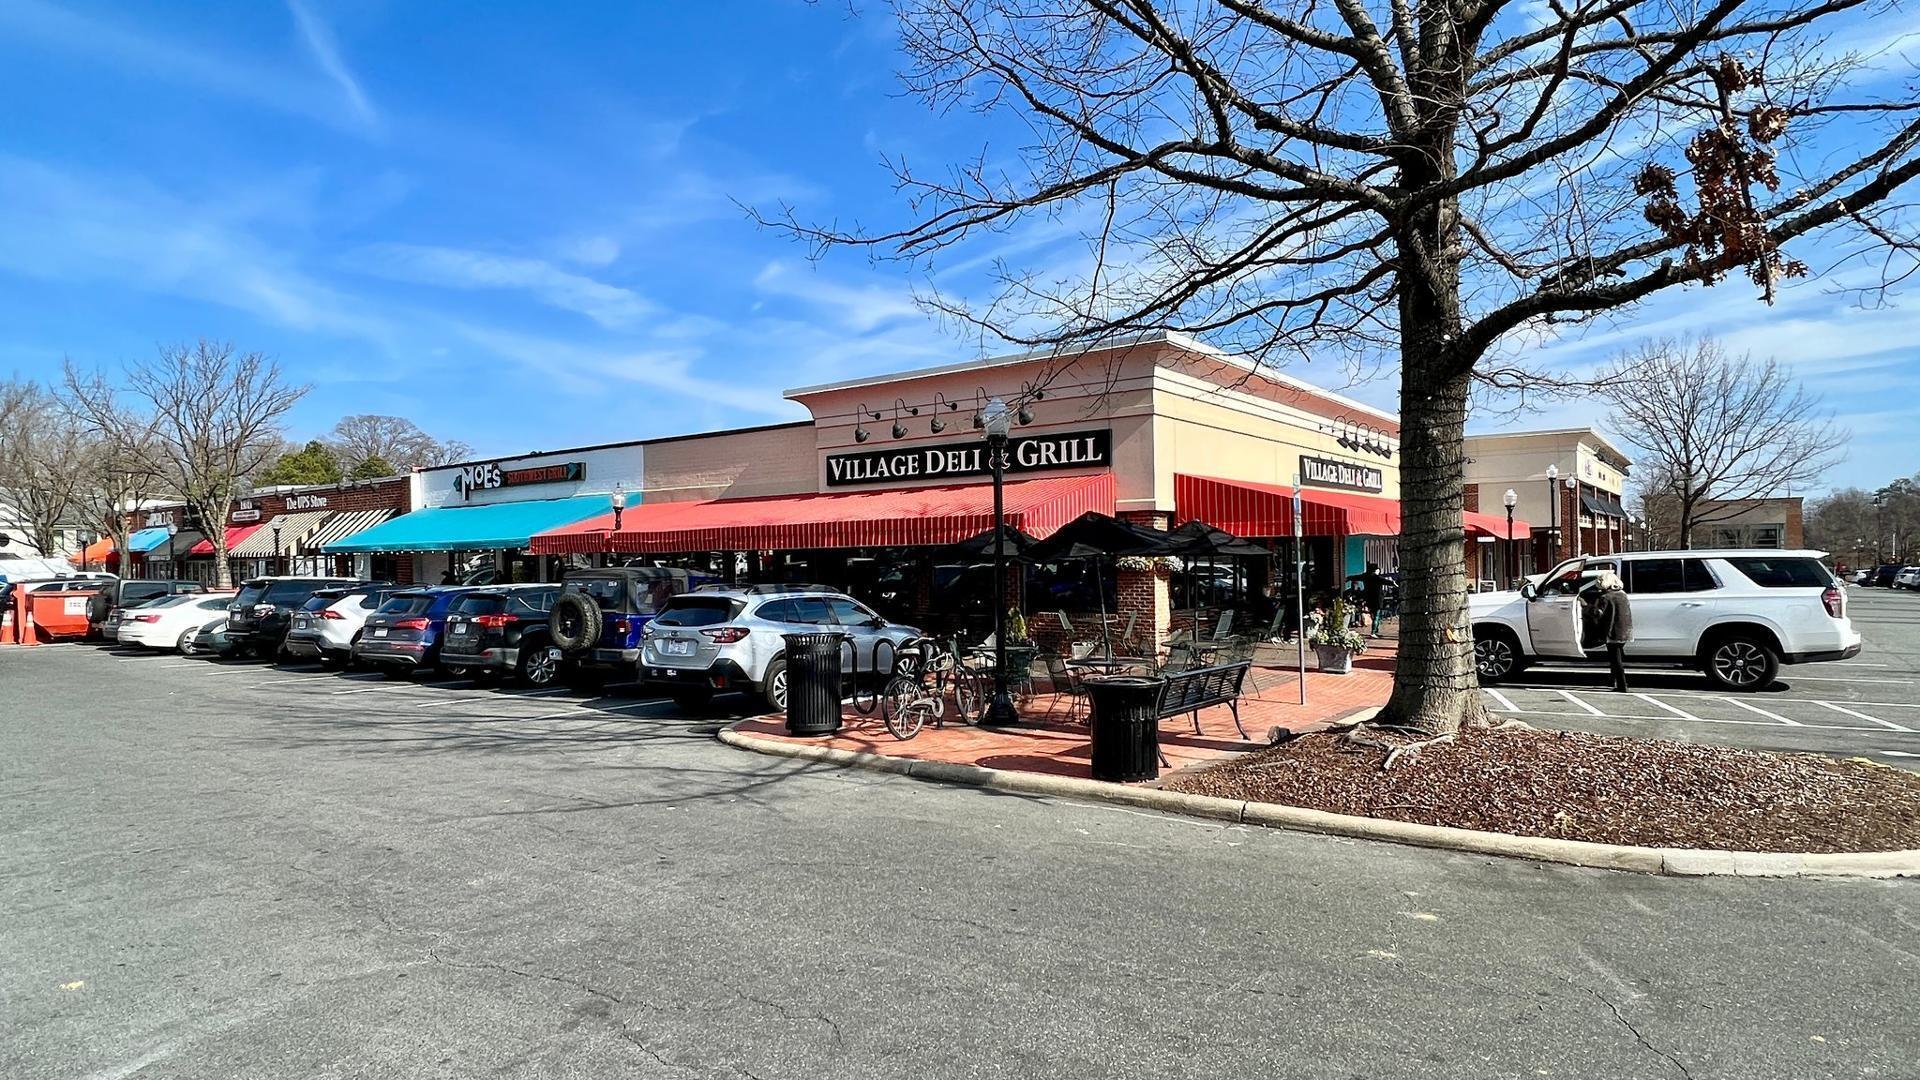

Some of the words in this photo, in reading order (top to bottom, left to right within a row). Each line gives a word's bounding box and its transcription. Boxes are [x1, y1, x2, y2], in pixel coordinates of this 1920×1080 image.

[828, 453, 920, 481] VILLAGE
[924, 448, 982, 475] DELI
[1017, 436, 1103, 468] GRILL
[1303, 458, 1338, 483] VILLAGE
[1338, 464, 1356, 485] DELI
[1356, 469, 1363, 487] &
[1363, 468, 1382, 489] GRILL
[285, 497, 297, 510] The
[297, 495, 310, 509] UPS
[310, 494, 328, 508] Store
